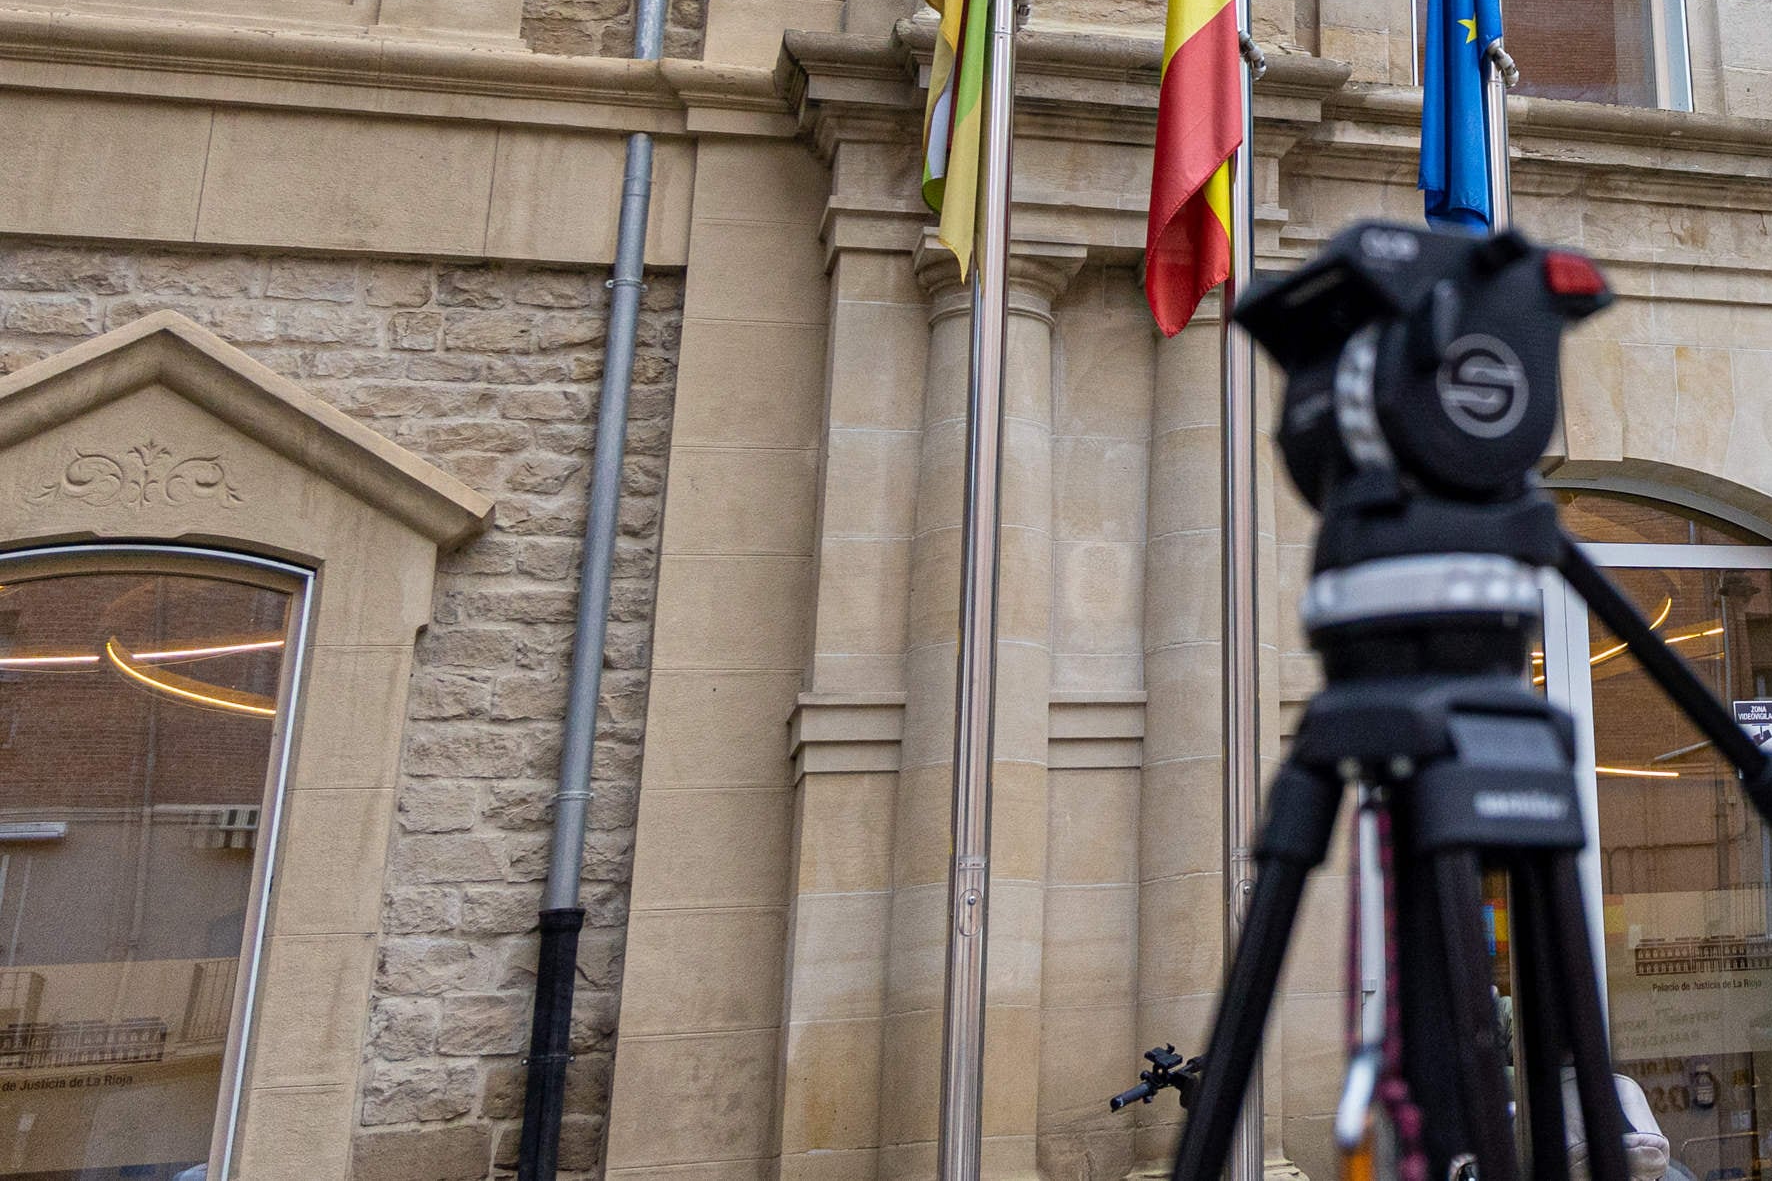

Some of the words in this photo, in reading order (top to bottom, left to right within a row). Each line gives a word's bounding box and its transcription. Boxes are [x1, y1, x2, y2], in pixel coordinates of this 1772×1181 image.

[1750, 705, 1767, 713] ZONA
[1652, 982, 1680, 992] Palacio
[1681, 982, 1690, 991] de
[1733, 979, 1742, 988] La
[1, 1081, 16, 1092] de
[20, 1078, 66, 1091] Justicia
[69, 1077, 84, 1088] de
[86, 1076, 100, 1087] La
[104, 1074, 133, 1087] Rioja
